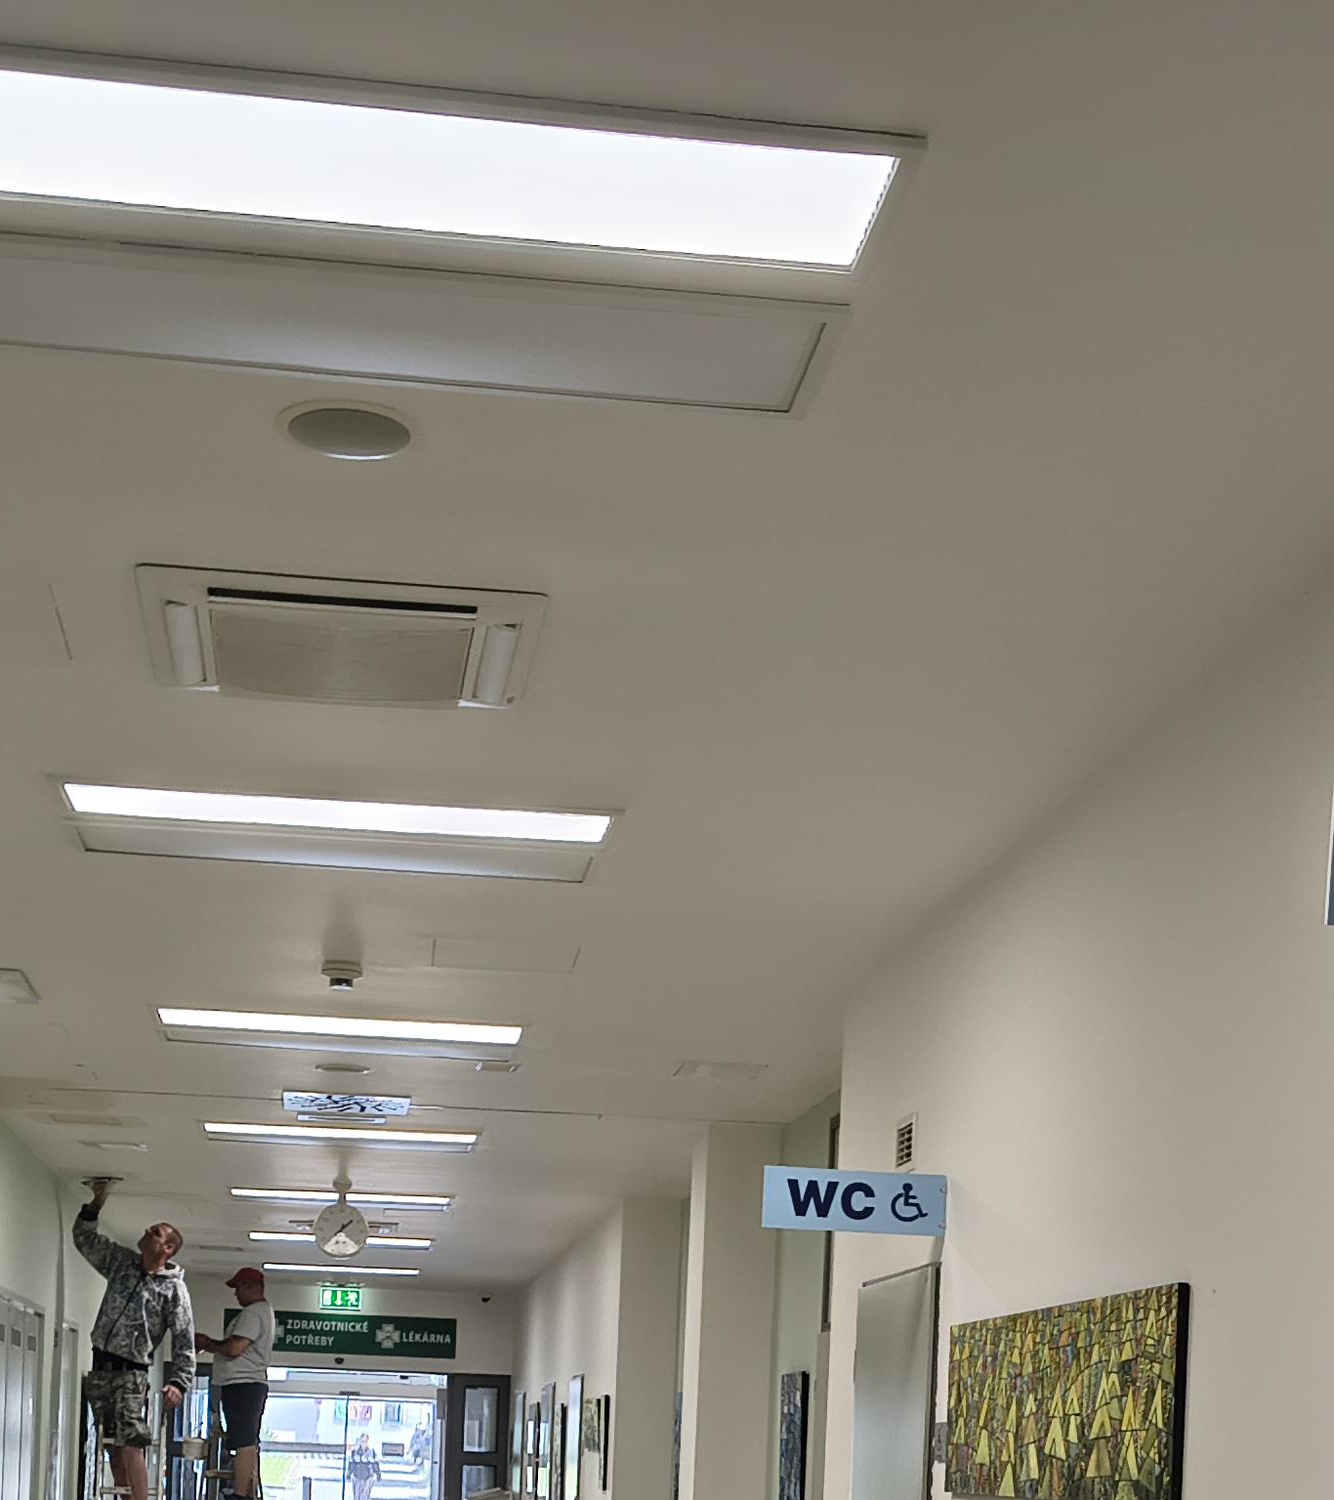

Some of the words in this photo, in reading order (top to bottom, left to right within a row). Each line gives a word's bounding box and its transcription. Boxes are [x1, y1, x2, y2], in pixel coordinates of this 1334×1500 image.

[787, 1179, 875, 1221] WC
[285, 1319, 369, 1333] ZDRAVOTNICKÉ
[285, 1334, 335, 1346] POTŘEBY
[402, 1331, 452, 1344] LÉKÁRNA
